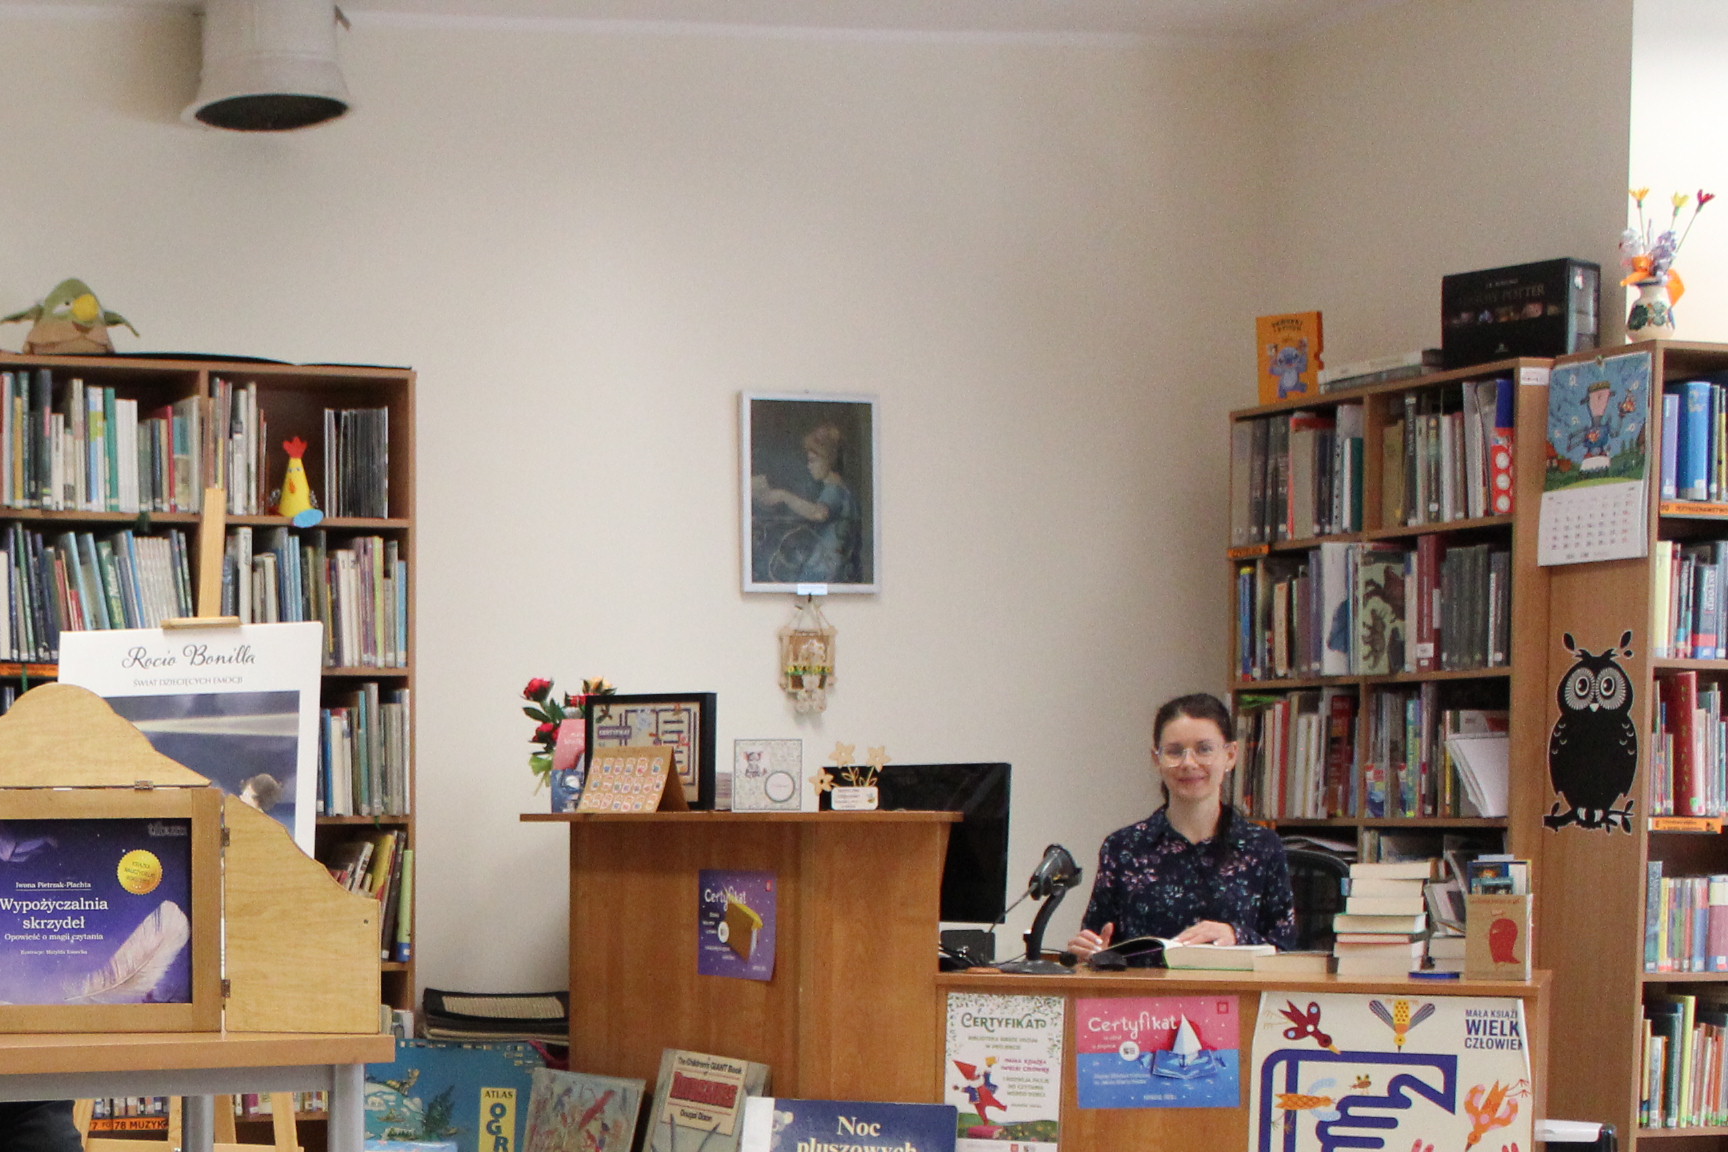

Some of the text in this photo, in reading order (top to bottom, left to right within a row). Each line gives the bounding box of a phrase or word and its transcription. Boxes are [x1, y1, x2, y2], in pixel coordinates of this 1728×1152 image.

[182, 644, 255, 666] Bonilla
[133, 677, 243, 687] ŚWIAT DZIECIĘCYCH EMOCJI
[0, 897, 109, 913] Wypożyczalnia
[22, 916, 85, 932] skrzydeł
[4, 933, 40, 942] Opowieść
[49, 933, 70, 943] magii
[71, 933, 103, 943] czytania
[1465, 1009, 1488, 1017] MAŁA
[961, 1012, 1046, 1032] CERTYFIKAT
[1088, 1011, 1178, 1040] Certyfikat
[484, 1090, 513, 1099] ATLAS
[837, 1115, 881, 1137] Noc
